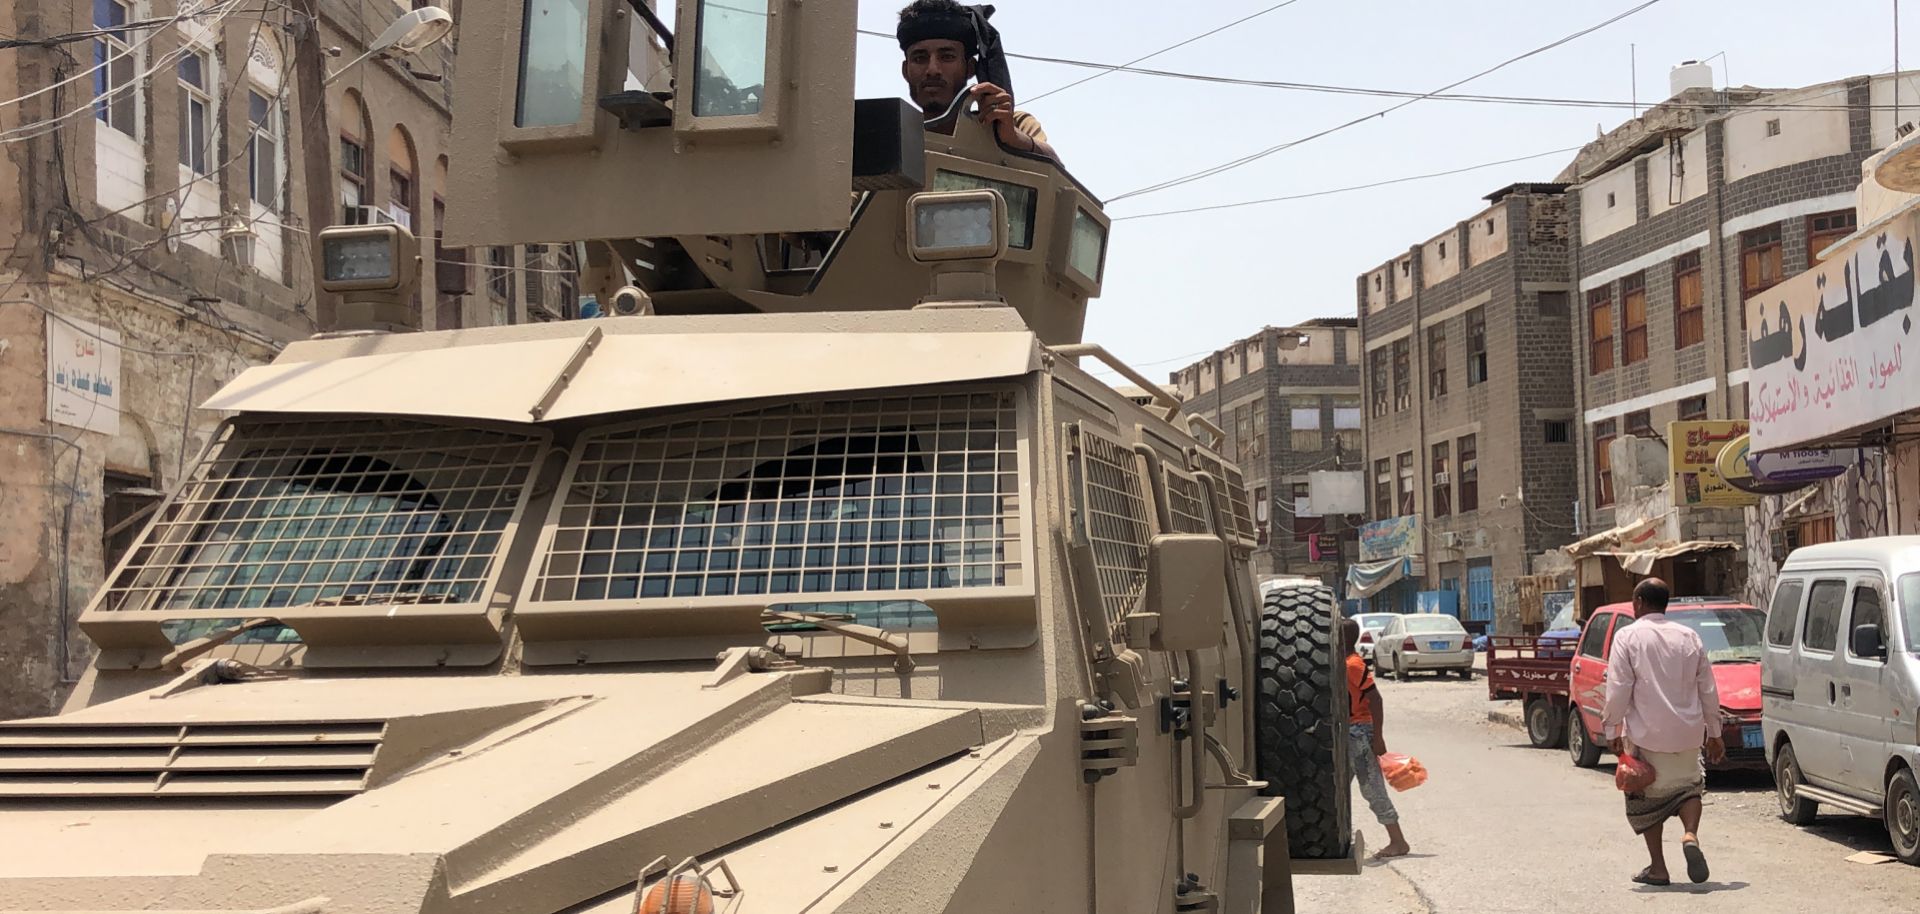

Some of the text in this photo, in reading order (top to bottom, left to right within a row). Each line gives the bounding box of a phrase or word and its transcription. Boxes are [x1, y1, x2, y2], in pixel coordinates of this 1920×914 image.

[1750, 231, 1915, 371] بقالة رهف
[75, 338, 95, 358] شارع
[1869, 342, 1902, 391] للمواد
[1814, 356, 1859, 409] الغذائية
